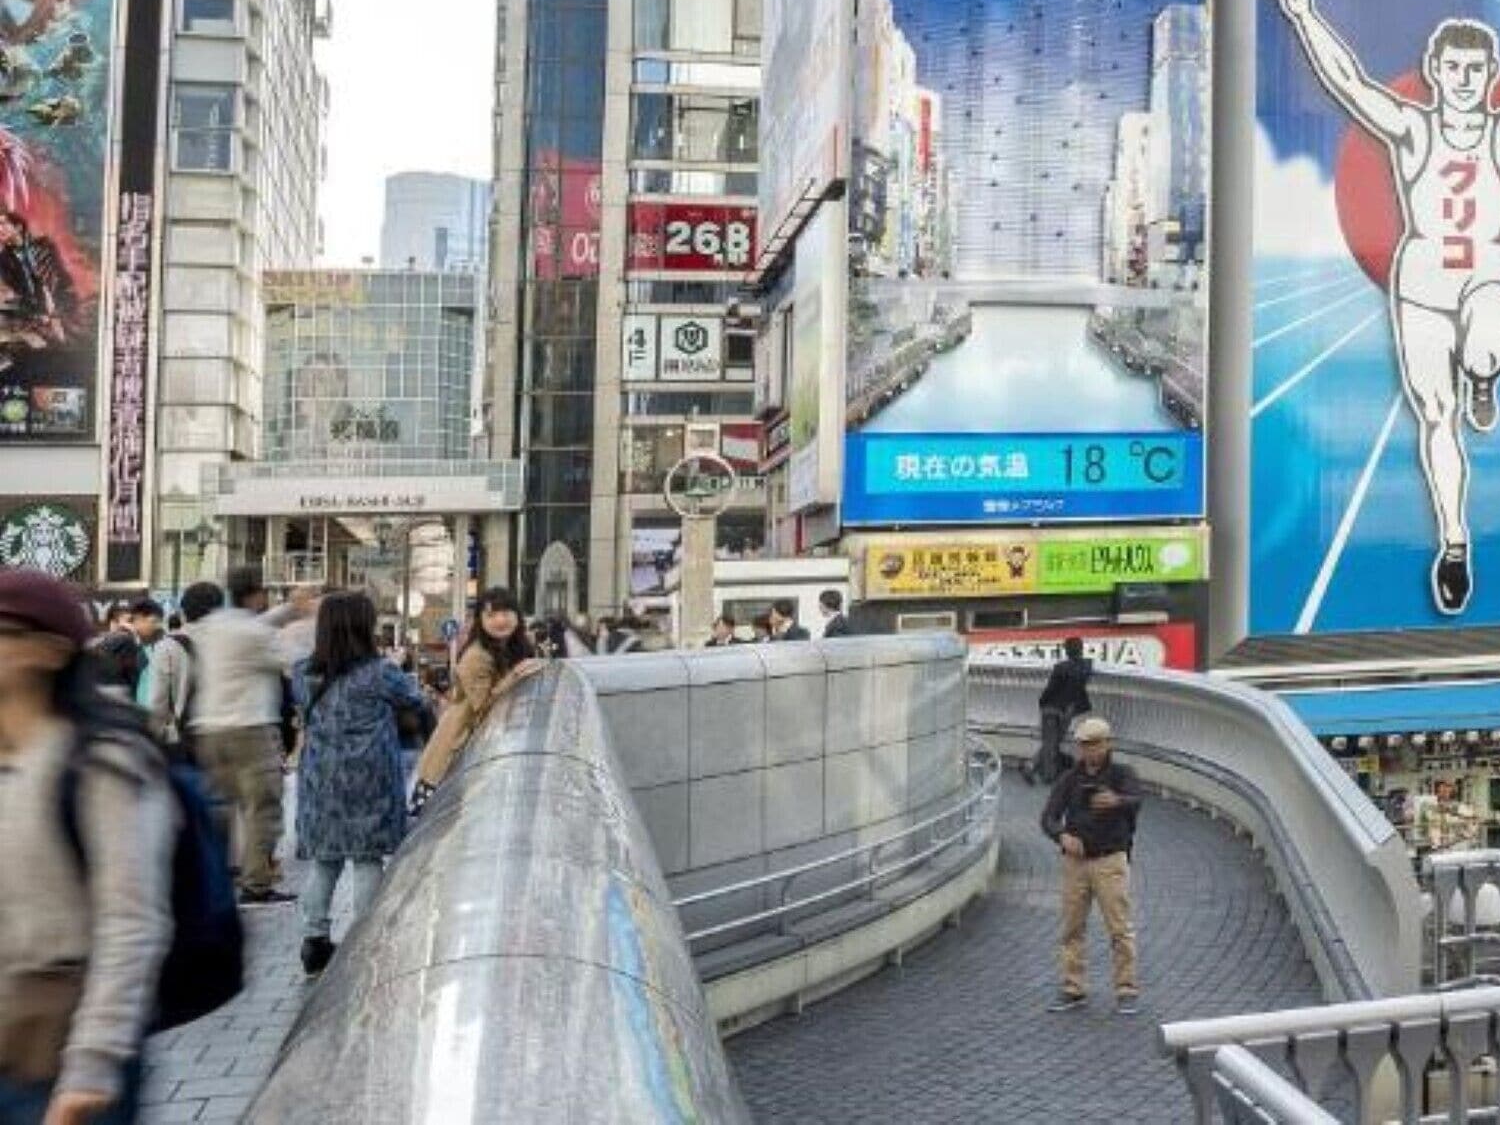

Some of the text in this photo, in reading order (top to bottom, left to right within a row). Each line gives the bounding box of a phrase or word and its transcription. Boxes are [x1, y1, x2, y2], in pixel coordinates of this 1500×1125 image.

[1440, 153, 1480, 271] グリコ
[895, 451, 1030, 481] 現在の気温
[1061, 442, 1107, 487] 18
